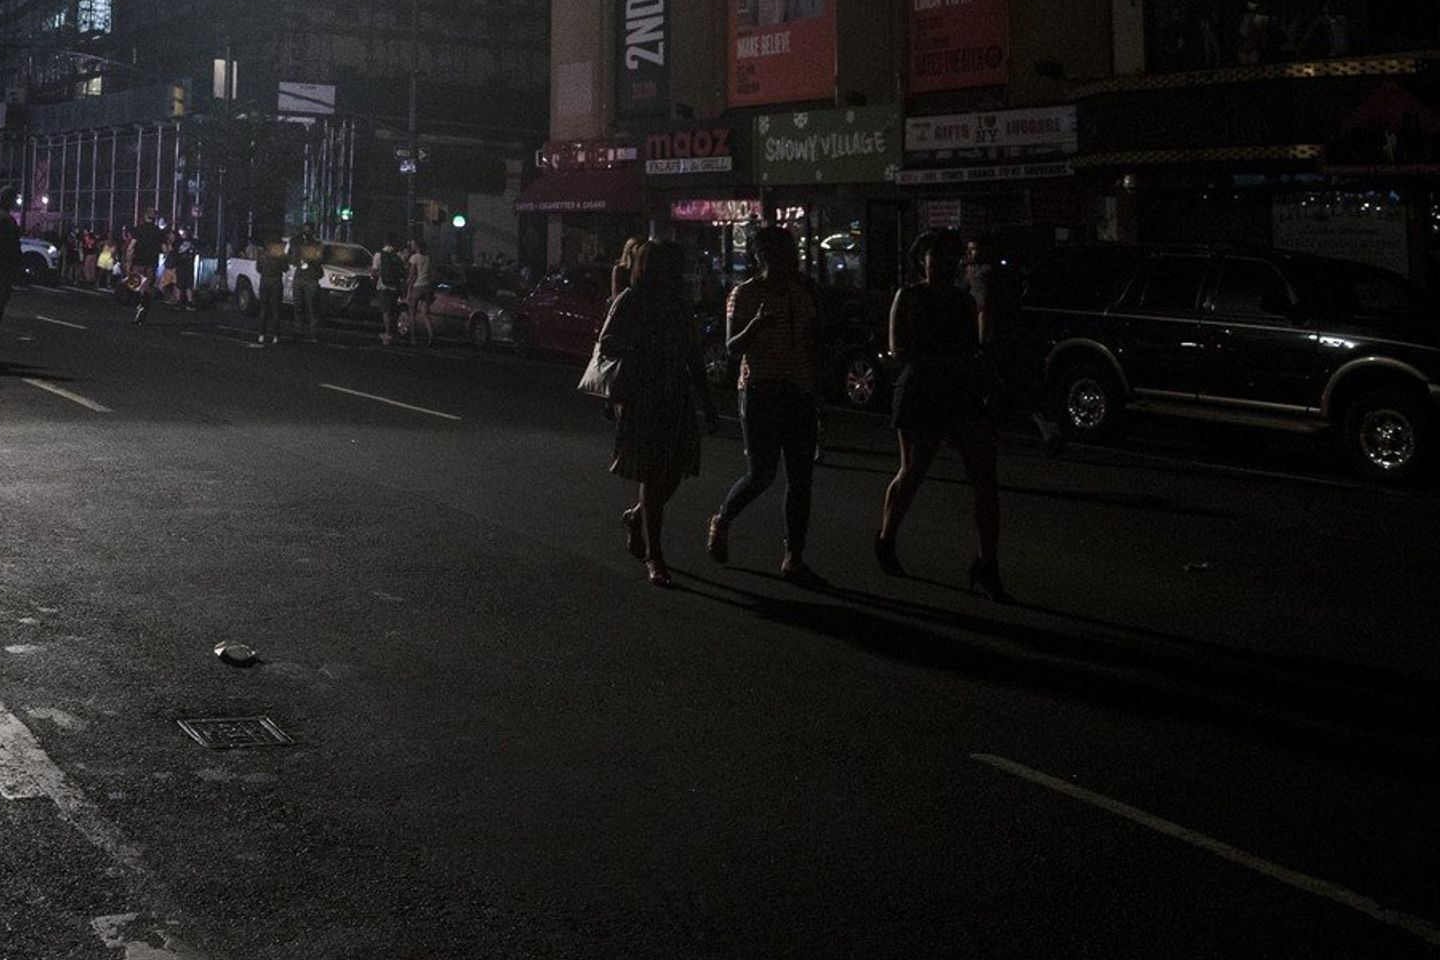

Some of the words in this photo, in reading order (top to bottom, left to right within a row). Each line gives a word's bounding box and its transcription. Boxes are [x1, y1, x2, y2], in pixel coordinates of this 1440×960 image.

[646, 128, 730, 159] maoz
[765, 134, 818, 162] SNOWY
[821, 132, 886, 158] VILLAGE
